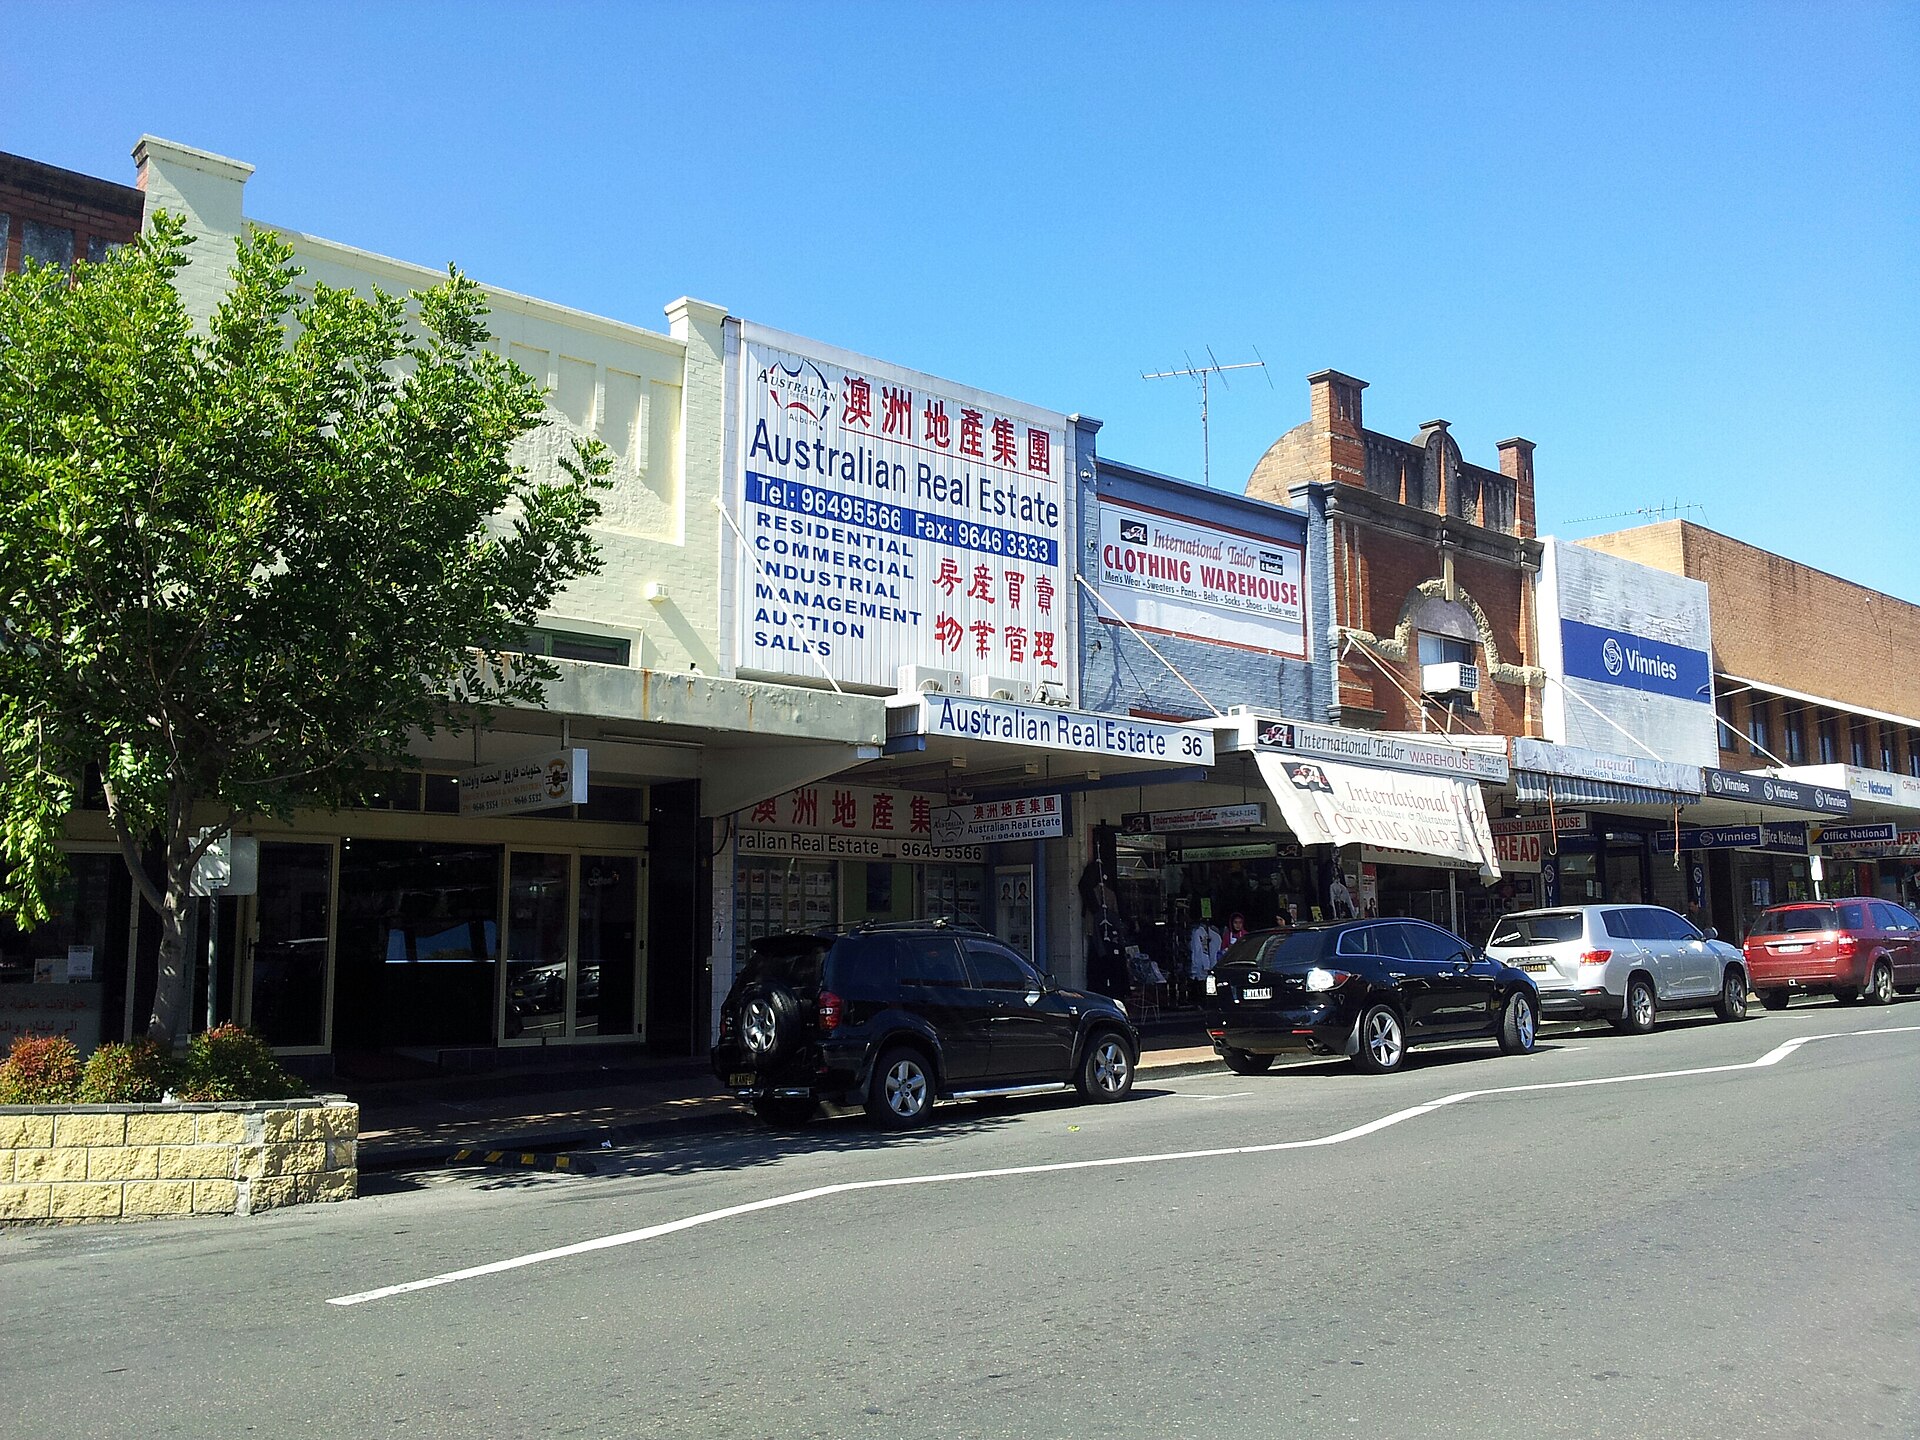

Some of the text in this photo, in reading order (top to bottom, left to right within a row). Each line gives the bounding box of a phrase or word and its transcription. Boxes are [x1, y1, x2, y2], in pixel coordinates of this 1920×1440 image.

[757, 369, 837, 402] AUSTRALIAN
[842, 374, 1050, 476] 澳洲地產集團
[750, 418, 1059, 529] Australian Real Estate
[757, 477, 1049, 562] Tel: 96495566 Fax: 9646 3333
[757, 512, 914, 558] RESIDENTIAL
[755, 536, 914, 580] COMMERCIAL
[1153, 529, 1256, 569] International Tailor
[756, 559, 900, 600] INDUSTRIAL
[1104, 544, 1298, 606] CLOTHING WAREHOUSE
[1104, 571, 1123, 583] Men's
[1124, 574, 1140, 587] Wear
[1147, 579, 1174, 593] Sweaters
[1180, 586, 1197, 598] Pants
[1224, 595, 1240, 606] Socks
[1246, 599, 1262, 611] Shoes
[756, 583, 922, 626] MANAGEMENT
[755, 608, 865, 640] AUCTION
[934, 611, 1058, 669] 物業管理
[755, 632, 831, 656] SALES
[1625, 647, 1677, 680] Vinnies
[940, 698, 1202, 757] Australian Real Estate 36
[1299, 729, 1372, 756] International
[1373, 739, 1404, 760] Tailor
[1409, 751, 1476, 771] WAREHOUSE
[1594, 757, 1637, 774] menzil
[1582, 767, 1610, 780] turkish
[1868, 780, 1893, 796] National
[974, 797, 1055, 819] 澳洲地產集團
[1345, 781, 1449, 813] International
[1722, 778, 1847, 808] Vinnies Vinnies Vinnies
[968, 817, 1060, 834] Australian Real Estate
[1525, 819, 1549, 831] BAKE
[1551, 816, 1581, 829] HOUSE
[1716, 832, 1757, 842] Vinnies
[1778, 831, 1804, 846] National
[1823, 830, 1848, 841] Office
[1850, 828, 1888, 839] National
[791, 834, 824, 852] Real
[828, 836, 879, 855] Estate
[901, 842, 941, 858] 9649
[944, 846, 982, 861] 5566
